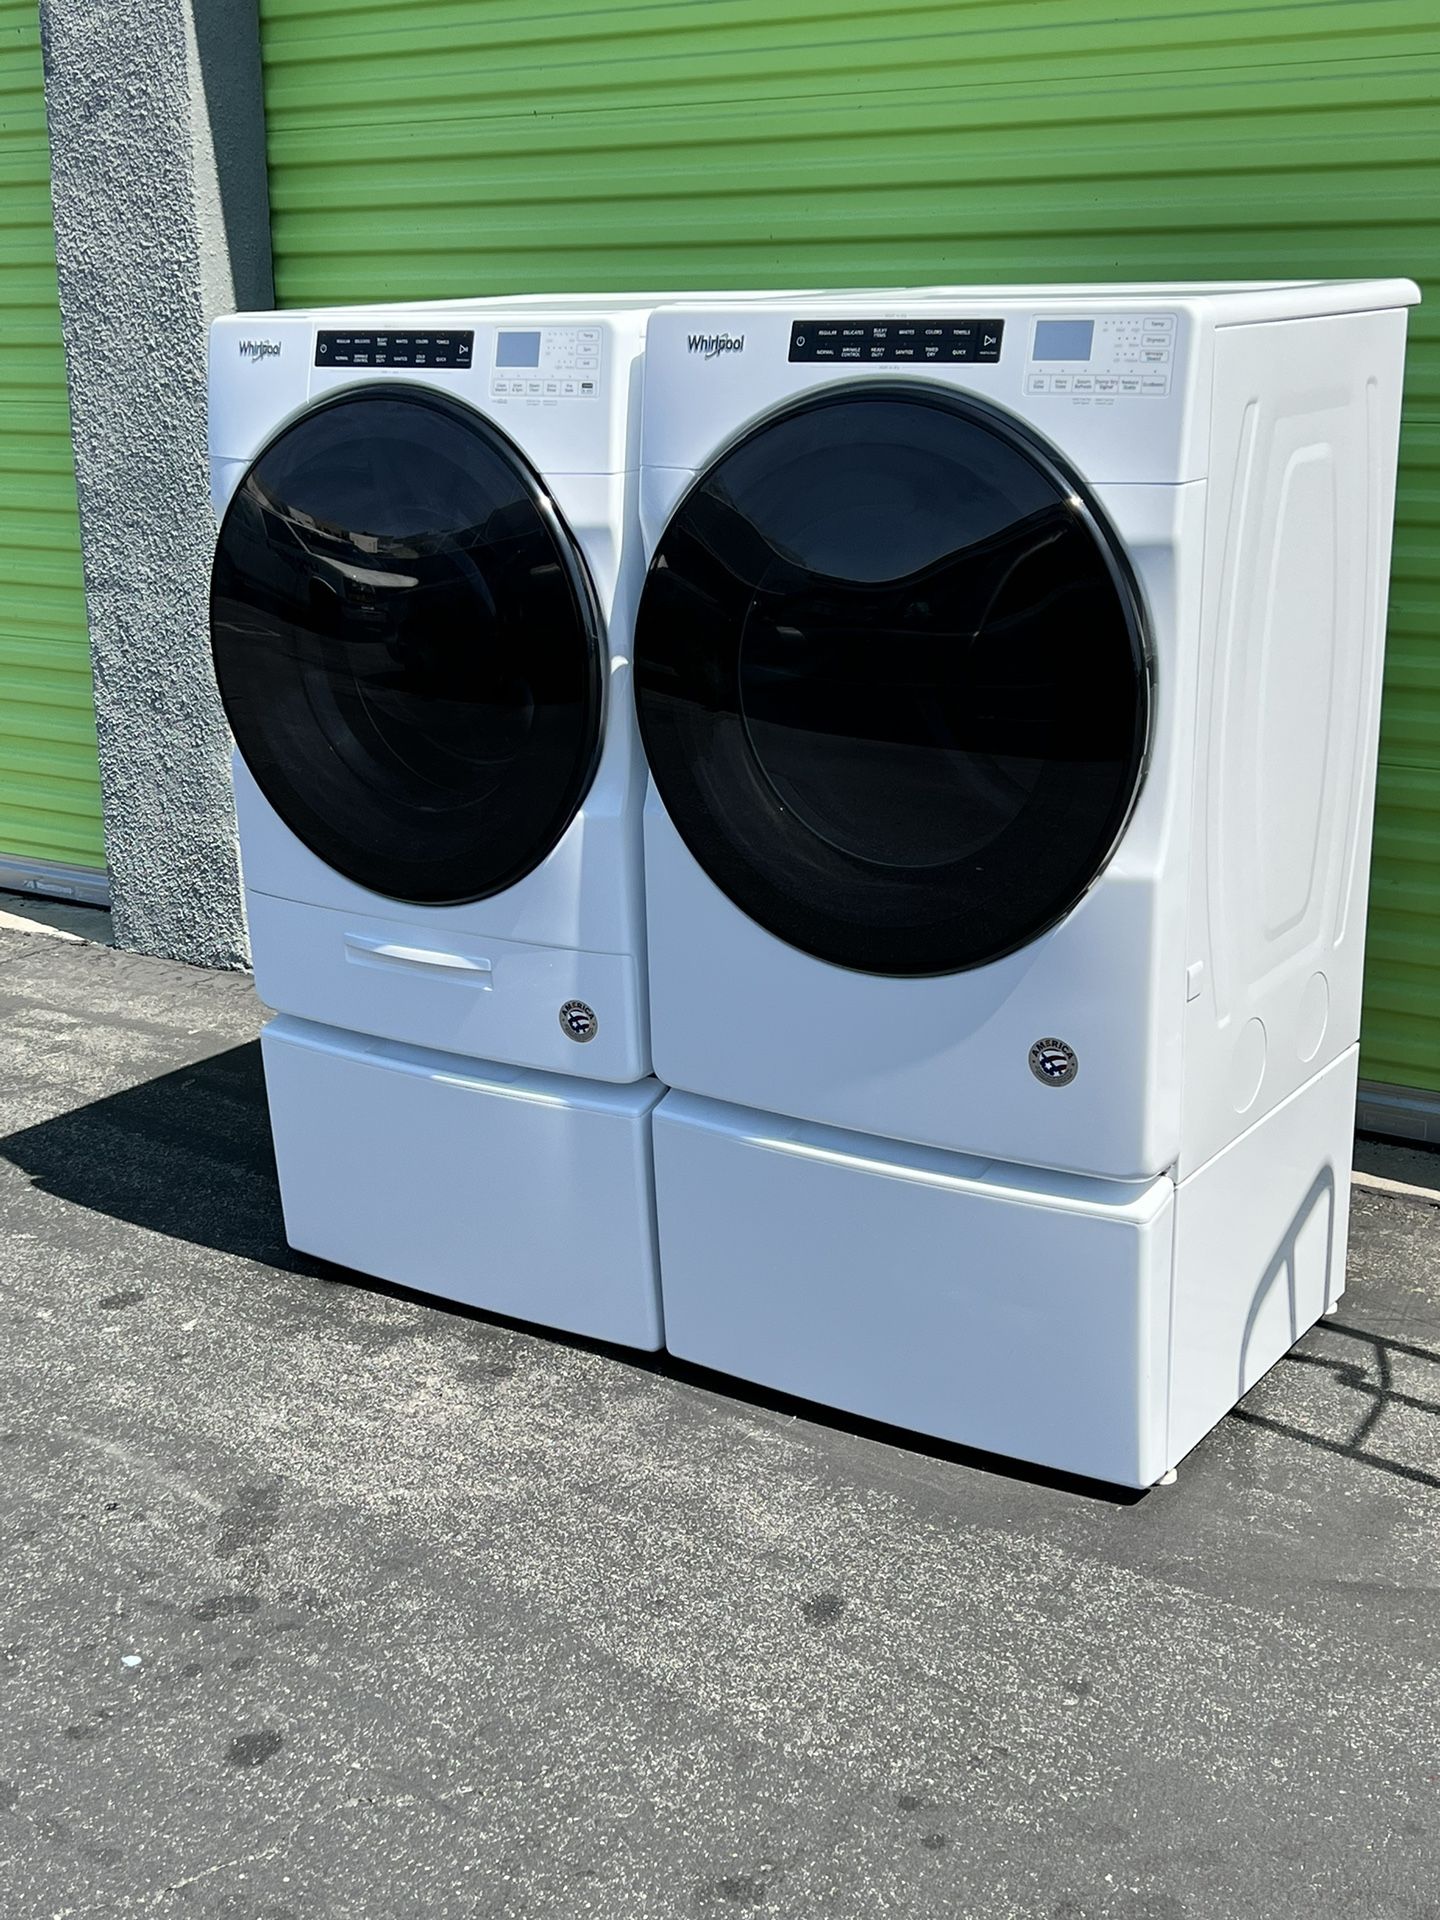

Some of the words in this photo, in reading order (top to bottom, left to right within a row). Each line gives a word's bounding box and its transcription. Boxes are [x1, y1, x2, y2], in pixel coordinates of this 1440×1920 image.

[239, 340, 281, 362] Whirlpool
[688, 334, 744, 358] Whirlpool
[561, 1001, 595, 1020] AMERICA
[1031, 1039, 1074, 1060] AMERICA
